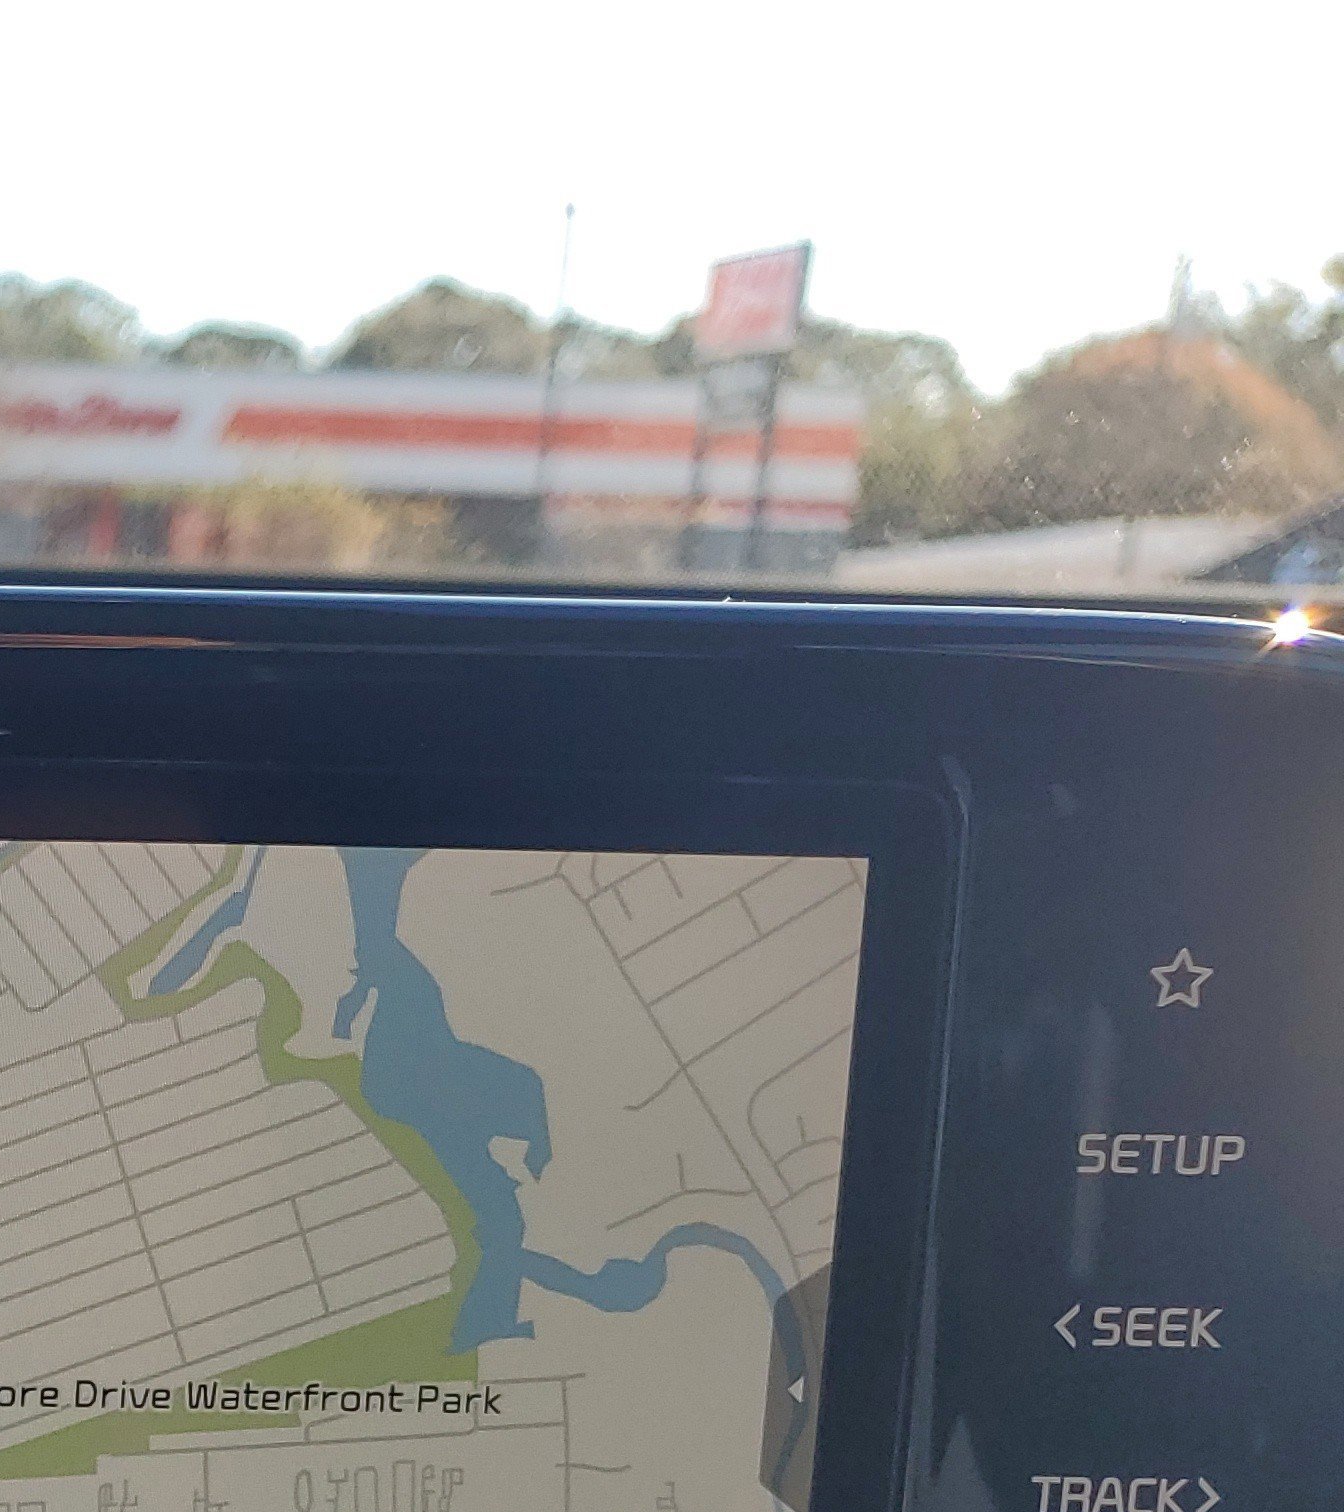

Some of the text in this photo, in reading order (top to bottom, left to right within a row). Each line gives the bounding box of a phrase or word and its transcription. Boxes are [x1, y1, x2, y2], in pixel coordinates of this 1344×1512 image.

[1076, 1133, 1246, 1176] SETUP
[1092, 1307, 1223, 1349] SEEK
[74, 1379, 171, 1409] Drive
[187, 1381, 404, 1412] Waterfront
[417, 1385, 502, 1415] Park
